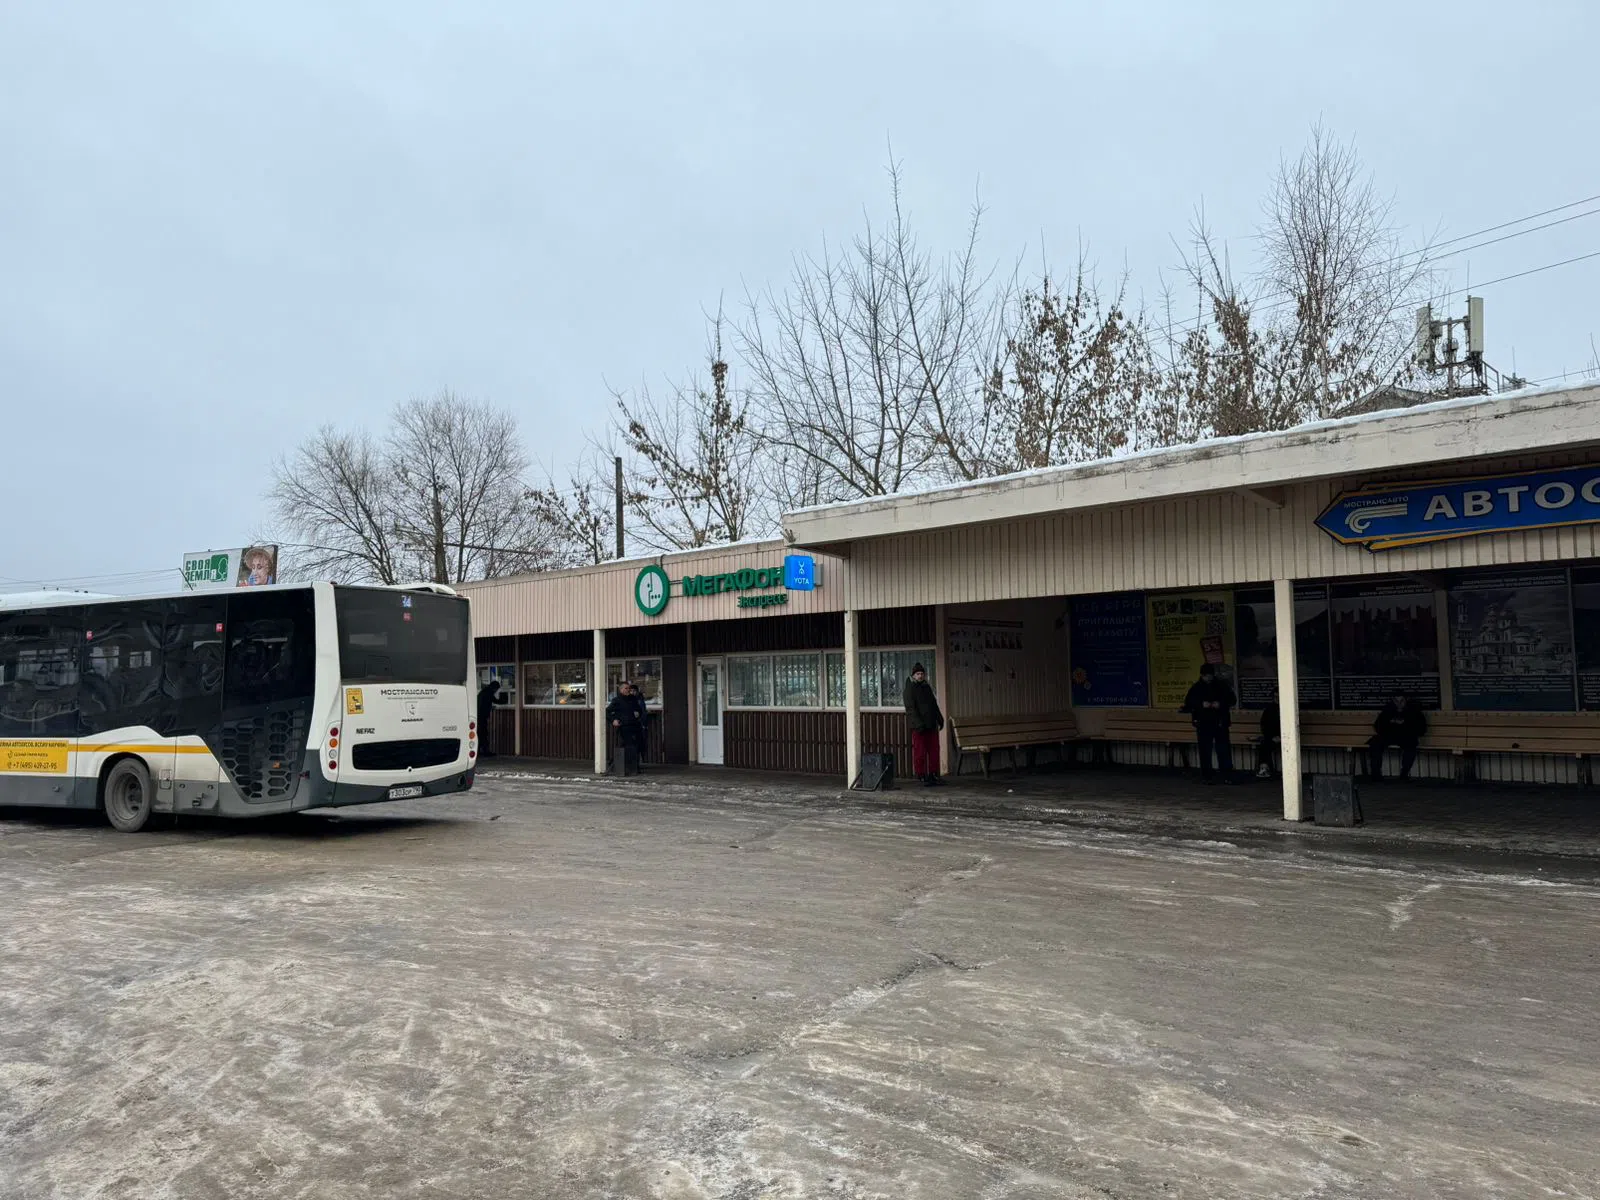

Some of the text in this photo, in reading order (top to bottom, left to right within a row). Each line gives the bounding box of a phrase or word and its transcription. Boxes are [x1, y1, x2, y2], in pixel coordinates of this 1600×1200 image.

[1344, 496, 1409, 508] МОСТРАНСАВТО
[186, 559, 210, 571] СВОЯ
[683, 566, 785, 596] МЕГАФОН
[794, 577, 809, 585] YOTA
[356, 727, 375, 735] NEFAZ
